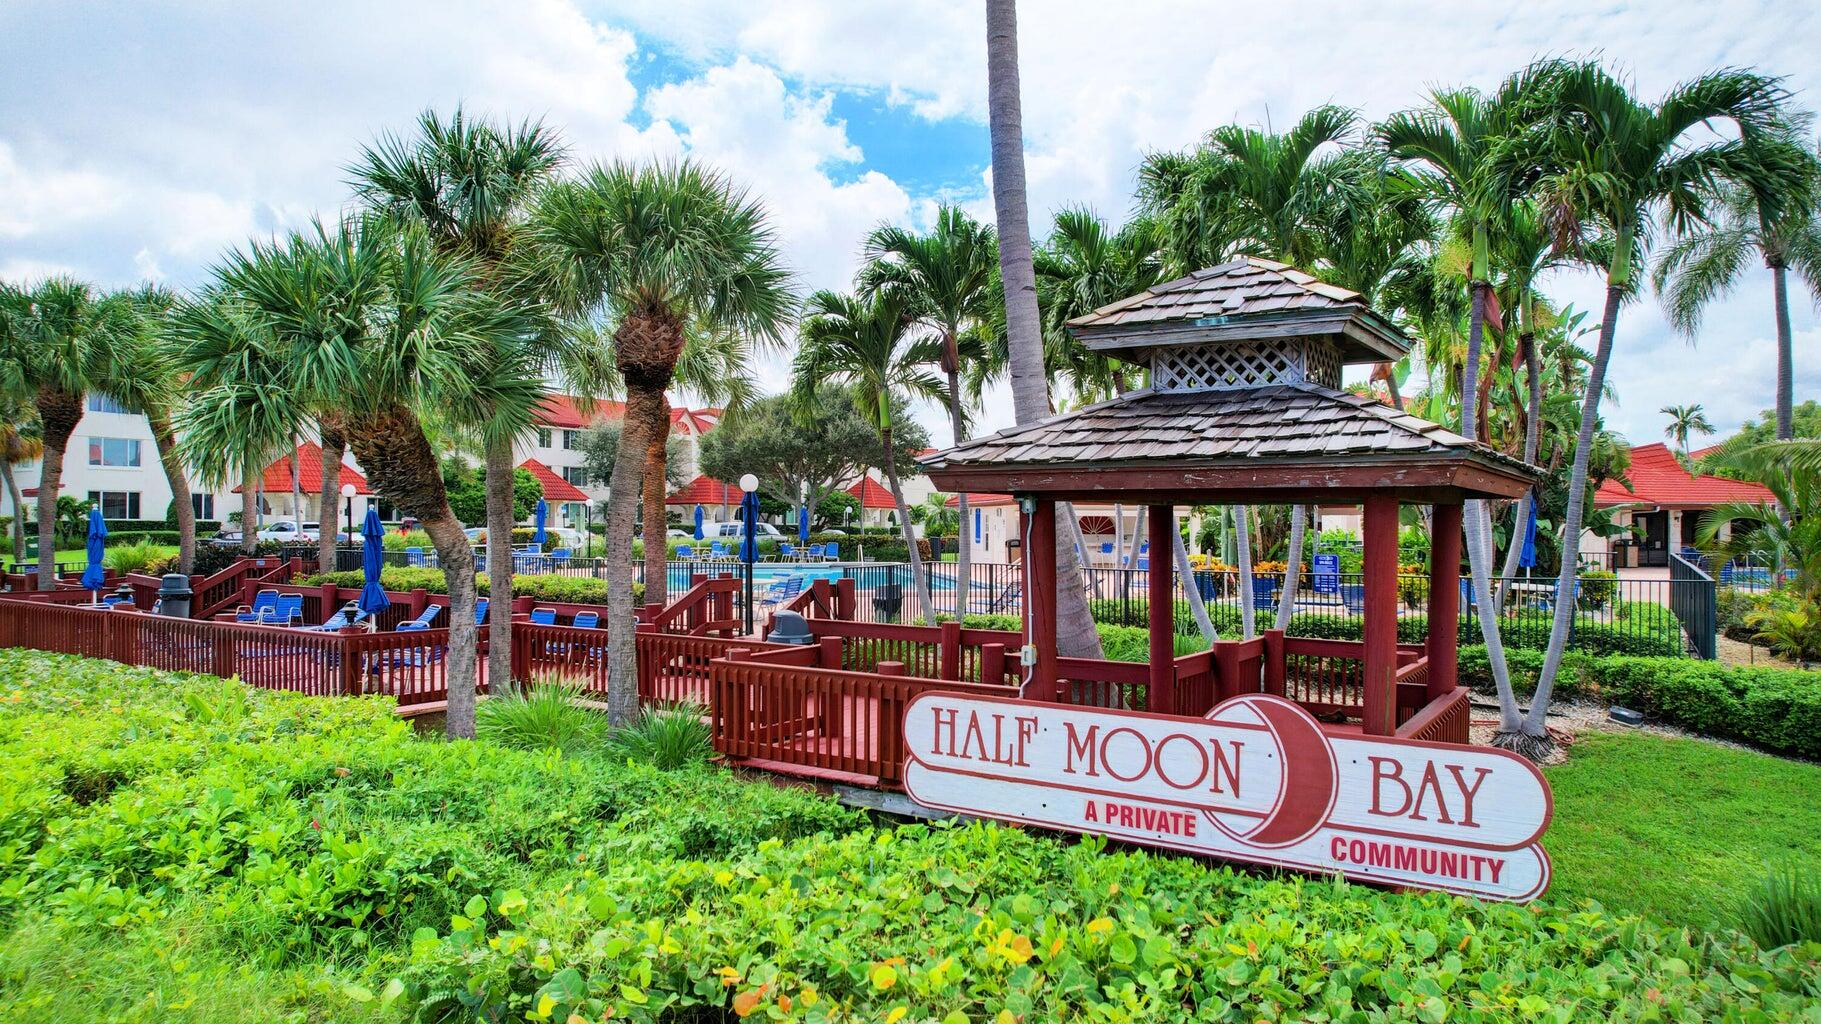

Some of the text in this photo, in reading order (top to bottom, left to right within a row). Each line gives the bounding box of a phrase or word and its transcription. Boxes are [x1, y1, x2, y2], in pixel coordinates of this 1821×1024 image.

[931, 707, 1493, 828] HALF MOON BAY
[1085, 801, 1505, 884] A PRIVATE COMMUNITY
